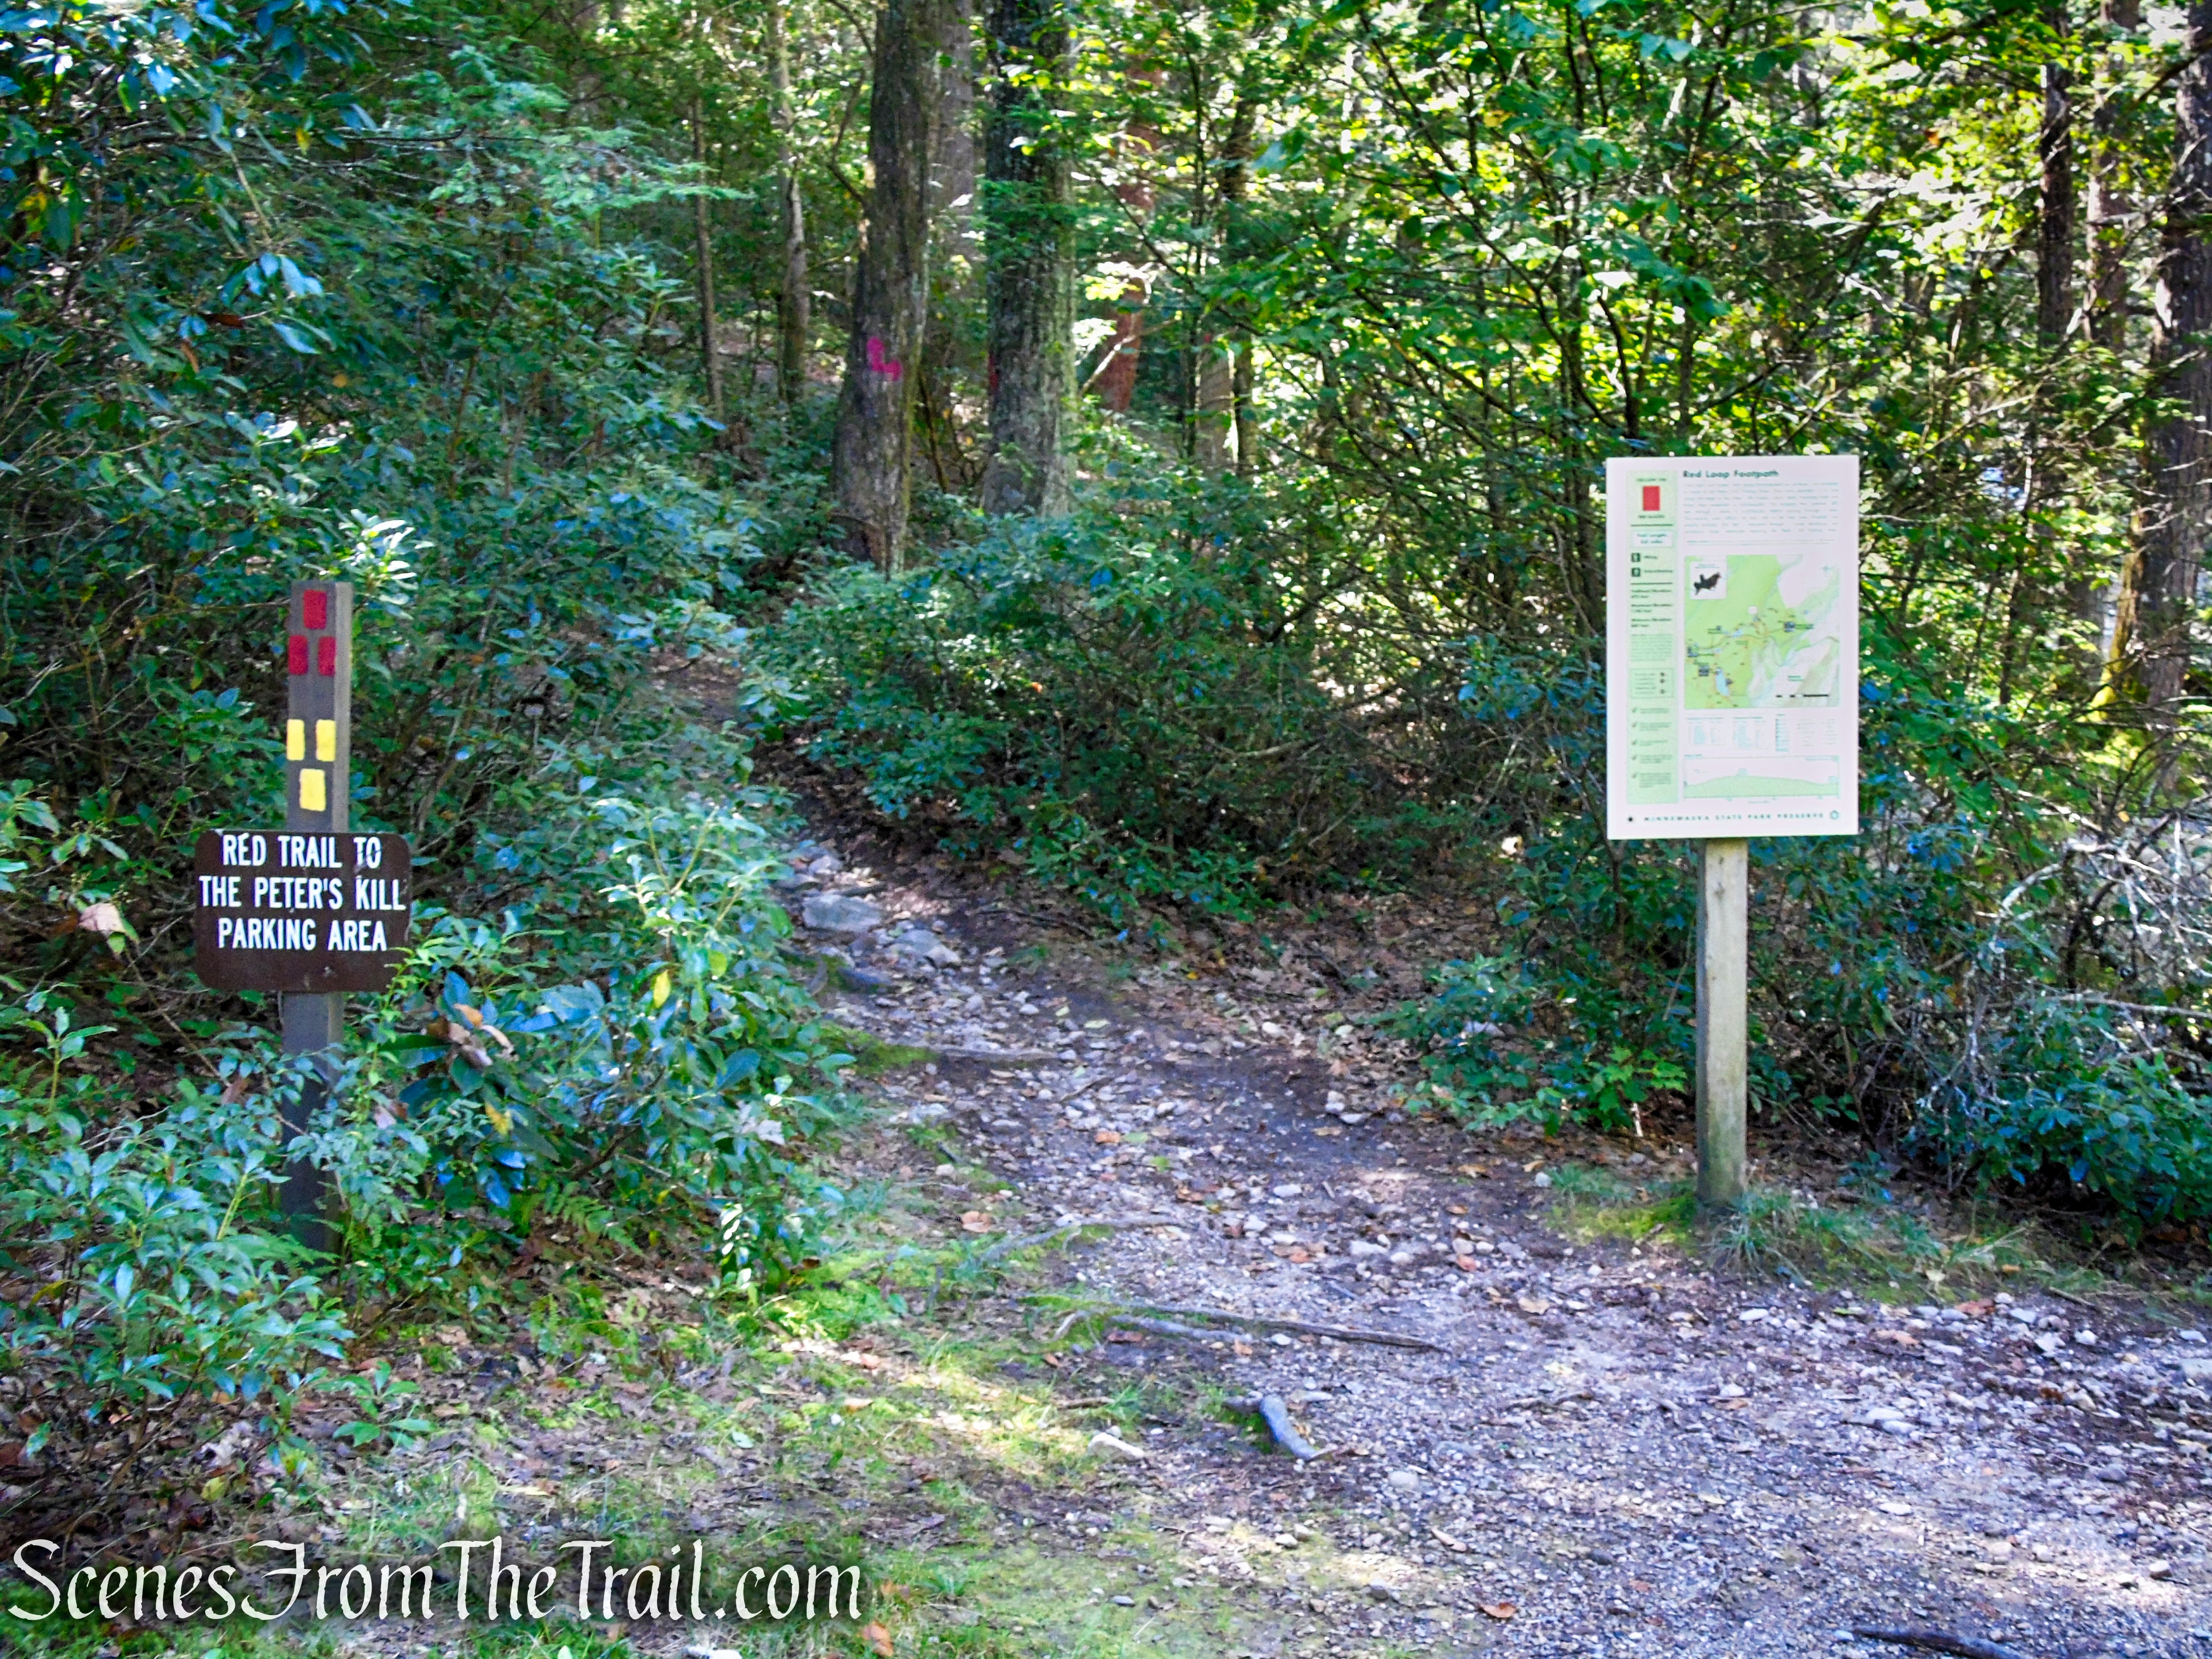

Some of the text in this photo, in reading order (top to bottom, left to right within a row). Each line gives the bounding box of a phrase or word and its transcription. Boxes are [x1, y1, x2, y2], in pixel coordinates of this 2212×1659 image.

[1683, 469, 1779, 479] Red Loop Footpath
[222, 833, 382, 869] RED TRAIL TO
[198, 875, 407, 911] THE PETER'S KILL
[218, 917, 387, 952] PARKING AREA
